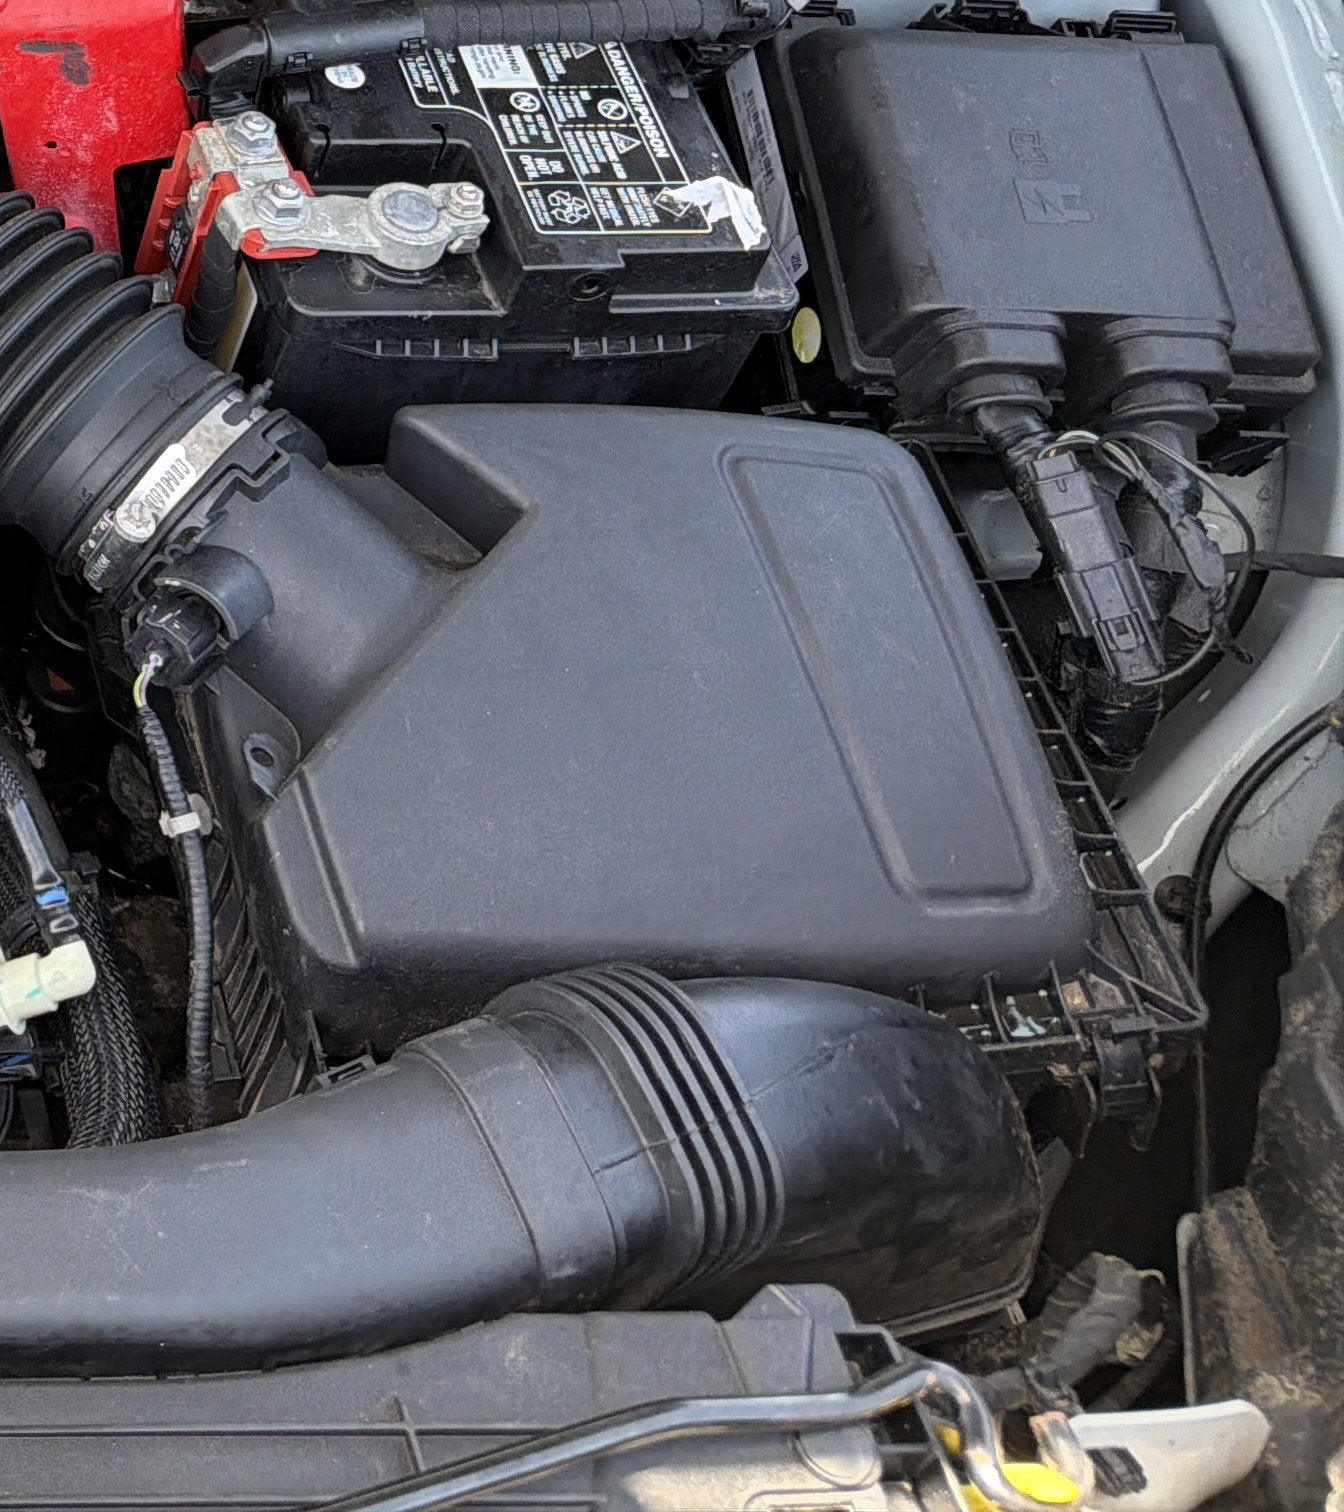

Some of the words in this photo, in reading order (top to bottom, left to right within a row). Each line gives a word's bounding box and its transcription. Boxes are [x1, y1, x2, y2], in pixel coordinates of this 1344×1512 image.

[605, 49, 671, 158] DANGER/POISON
[531, 157, 553, 175] NOT
[546, 160, 566, 173] DO
